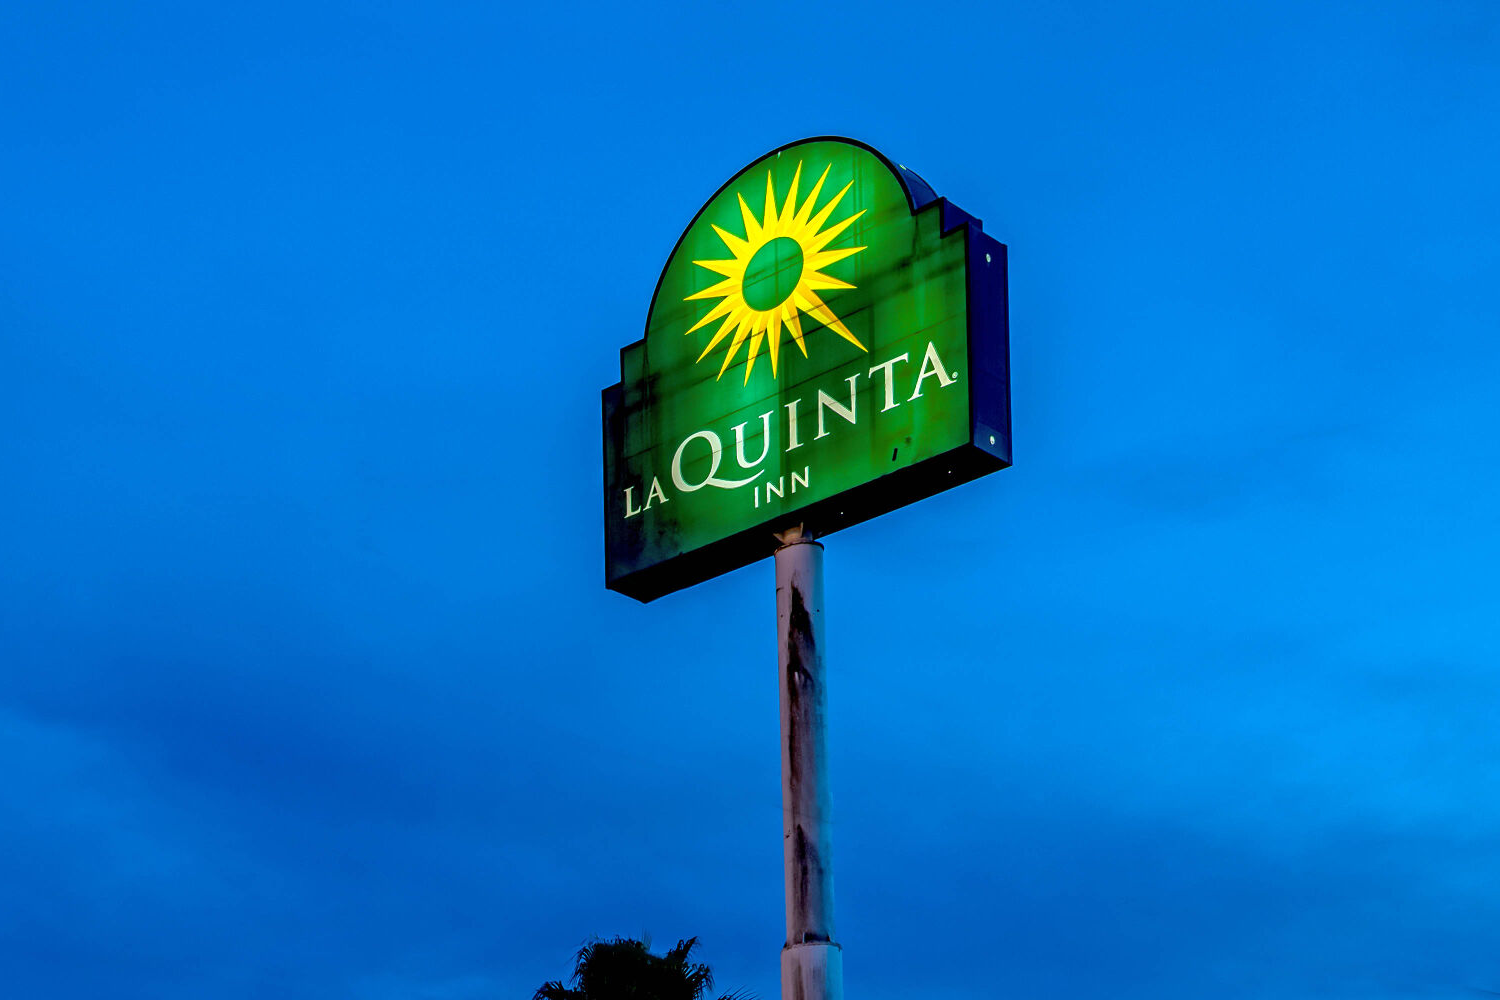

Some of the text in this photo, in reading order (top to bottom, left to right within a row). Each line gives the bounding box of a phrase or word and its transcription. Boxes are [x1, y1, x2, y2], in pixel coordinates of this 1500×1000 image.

[623, 341, 958, 519] LA QUINTA
[754, 466, 810, 508] INN
